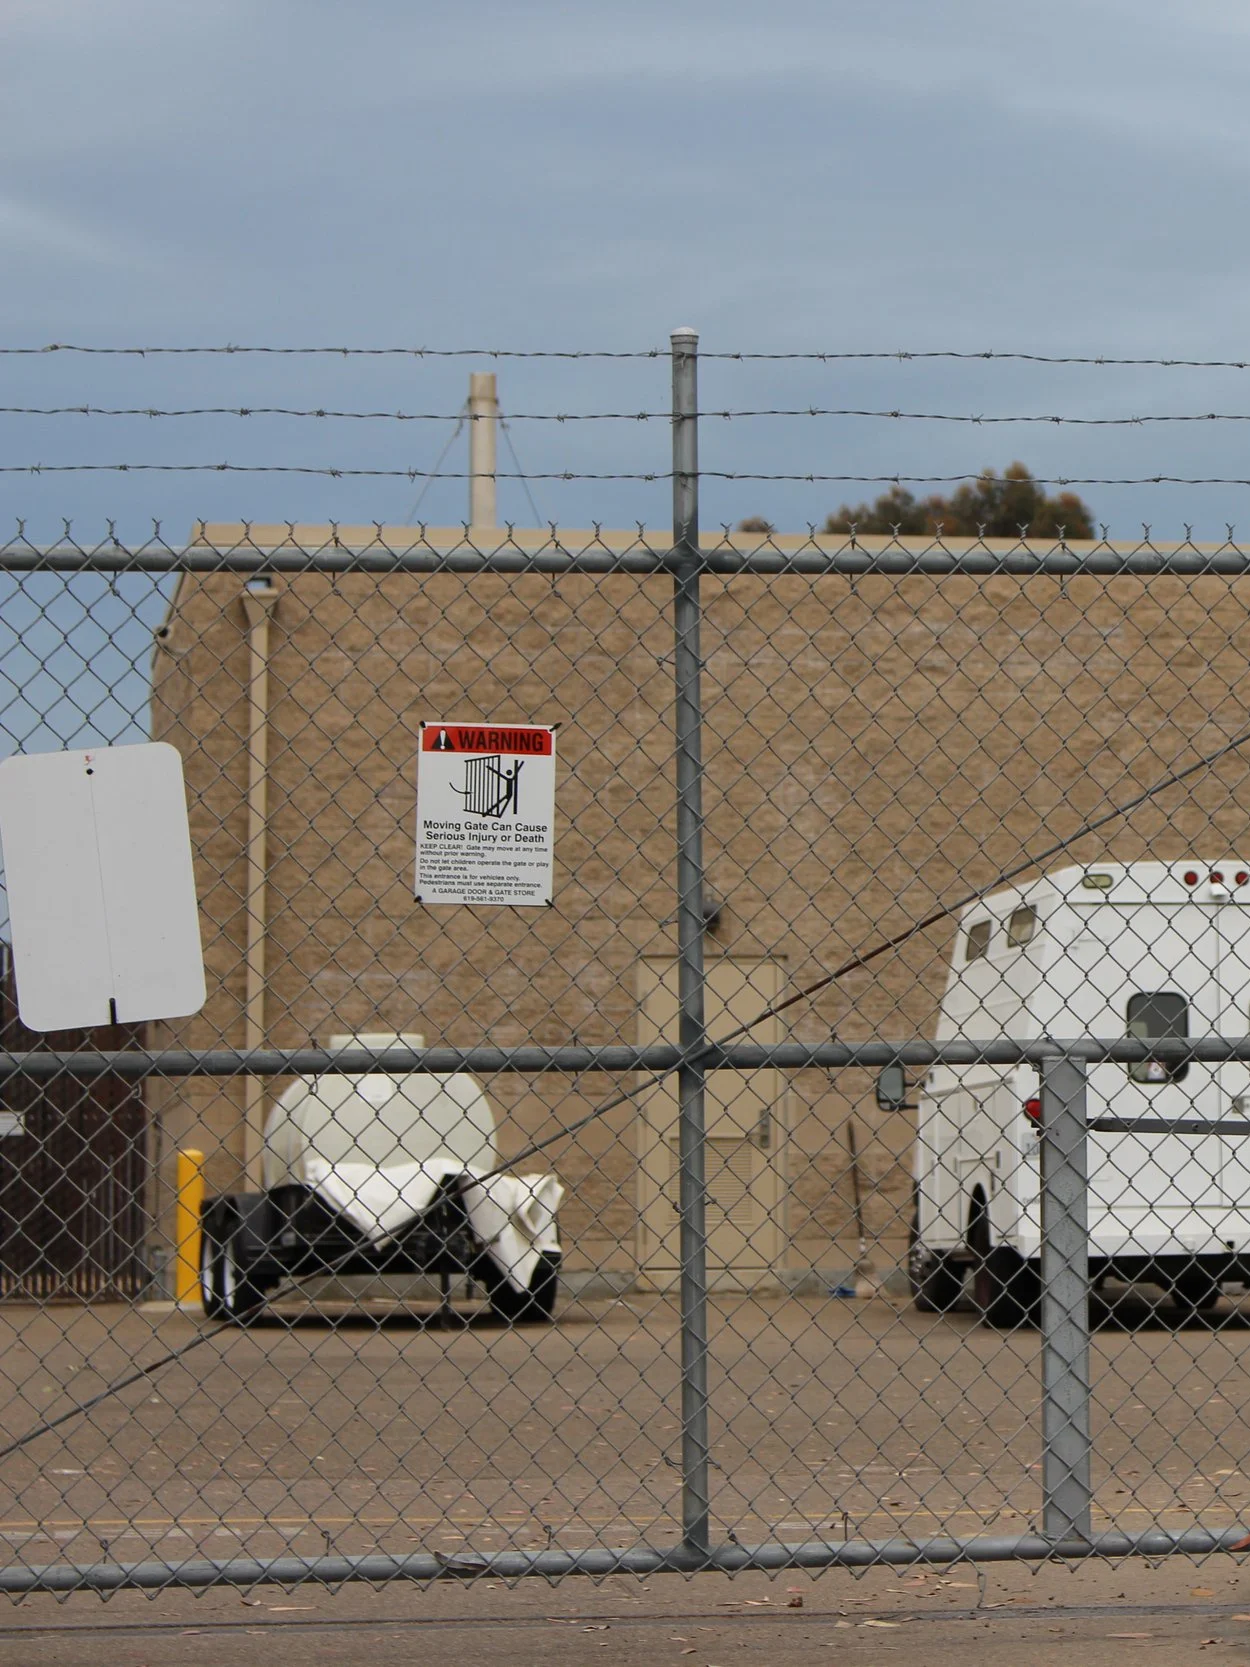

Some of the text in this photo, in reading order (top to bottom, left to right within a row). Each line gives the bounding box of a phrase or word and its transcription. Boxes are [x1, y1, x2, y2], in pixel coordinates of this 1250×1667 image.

[458, 730, 543, 752] WARNING
[423, 820, 548, 832] Moving Gate Can Cause
[426, 831, 465, 840] Serious
[468, 832, 498, 843] Injury
[514, 834, 544, 842] Death
